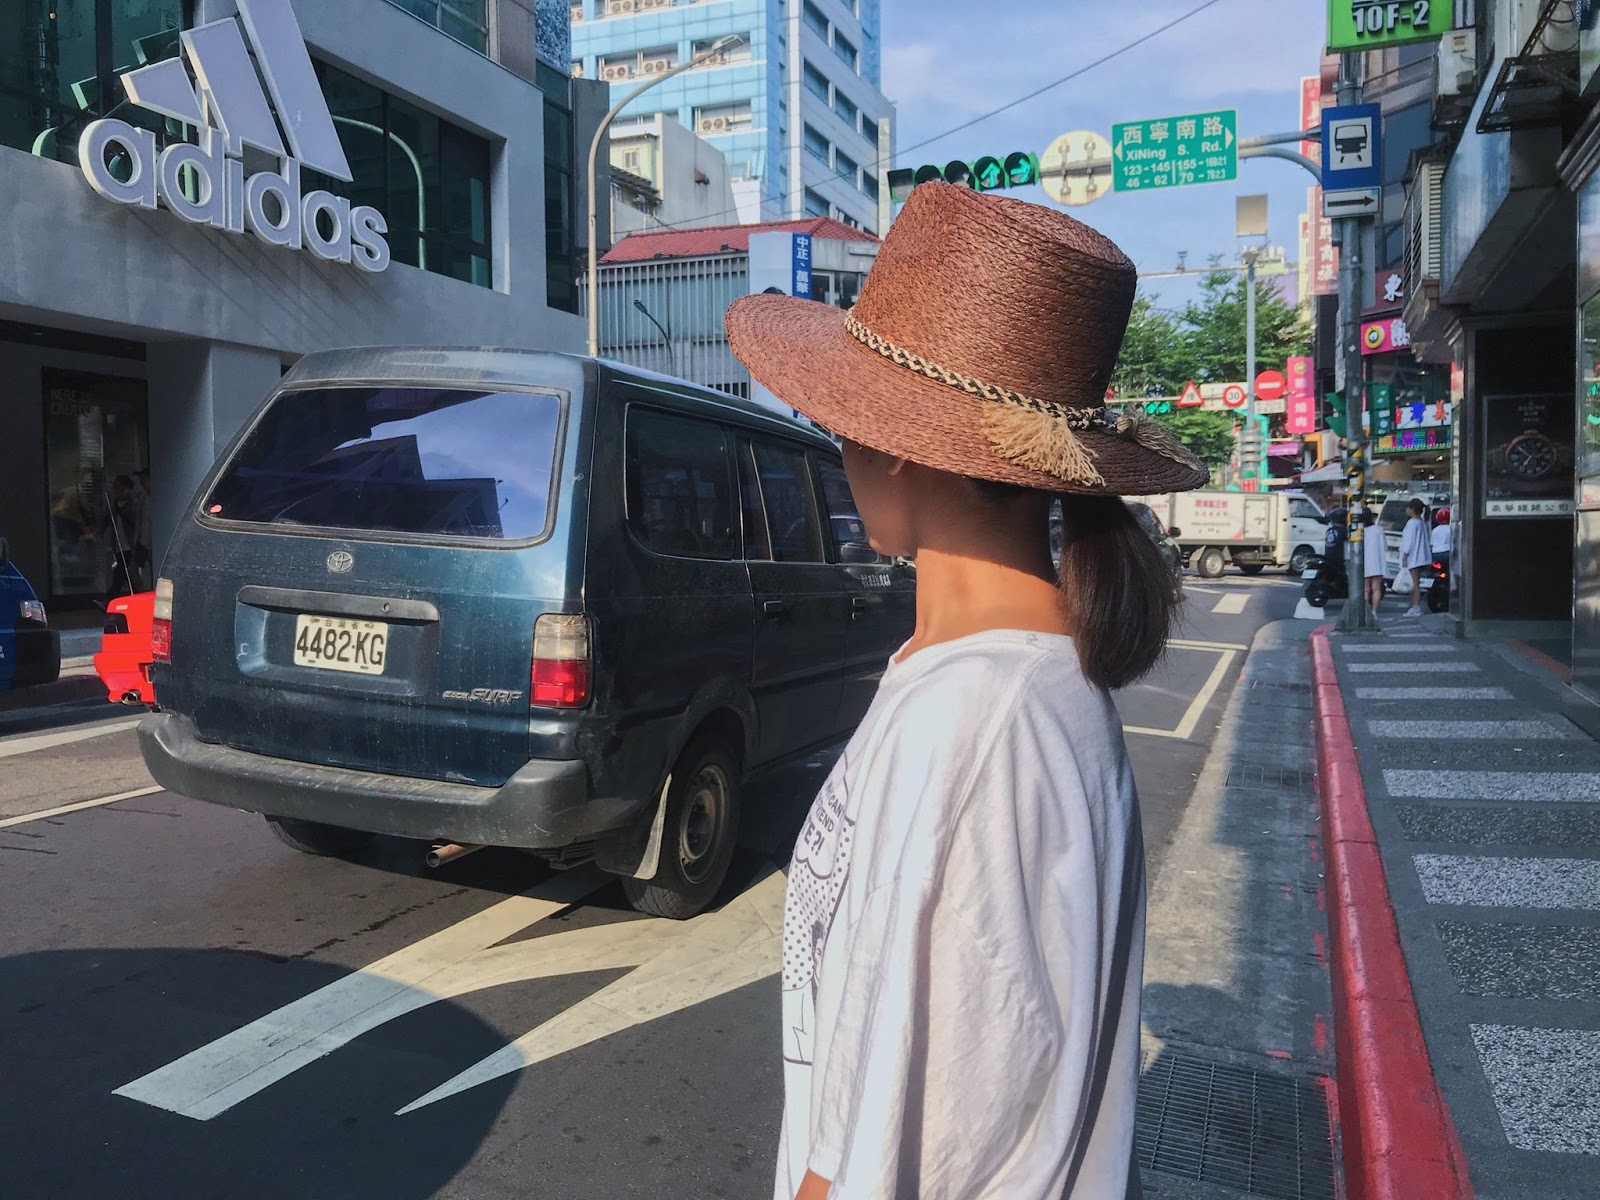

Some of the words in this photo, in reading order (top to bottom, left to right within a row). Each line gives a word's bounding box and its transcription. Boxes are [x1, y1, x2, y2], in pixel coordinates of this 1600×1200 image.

[1353, 0, 1429, 33] 10F-2
[1123, 117, 1223, 145] 西寧南路
[1177, 144, 1190, 155] S.
[1201, 140, 1223, 153] Rd.
[78, 118, 391, 272] adidas
[1228, 392, 1240, 400] 30
[471, 687, 524, 704] SURF
